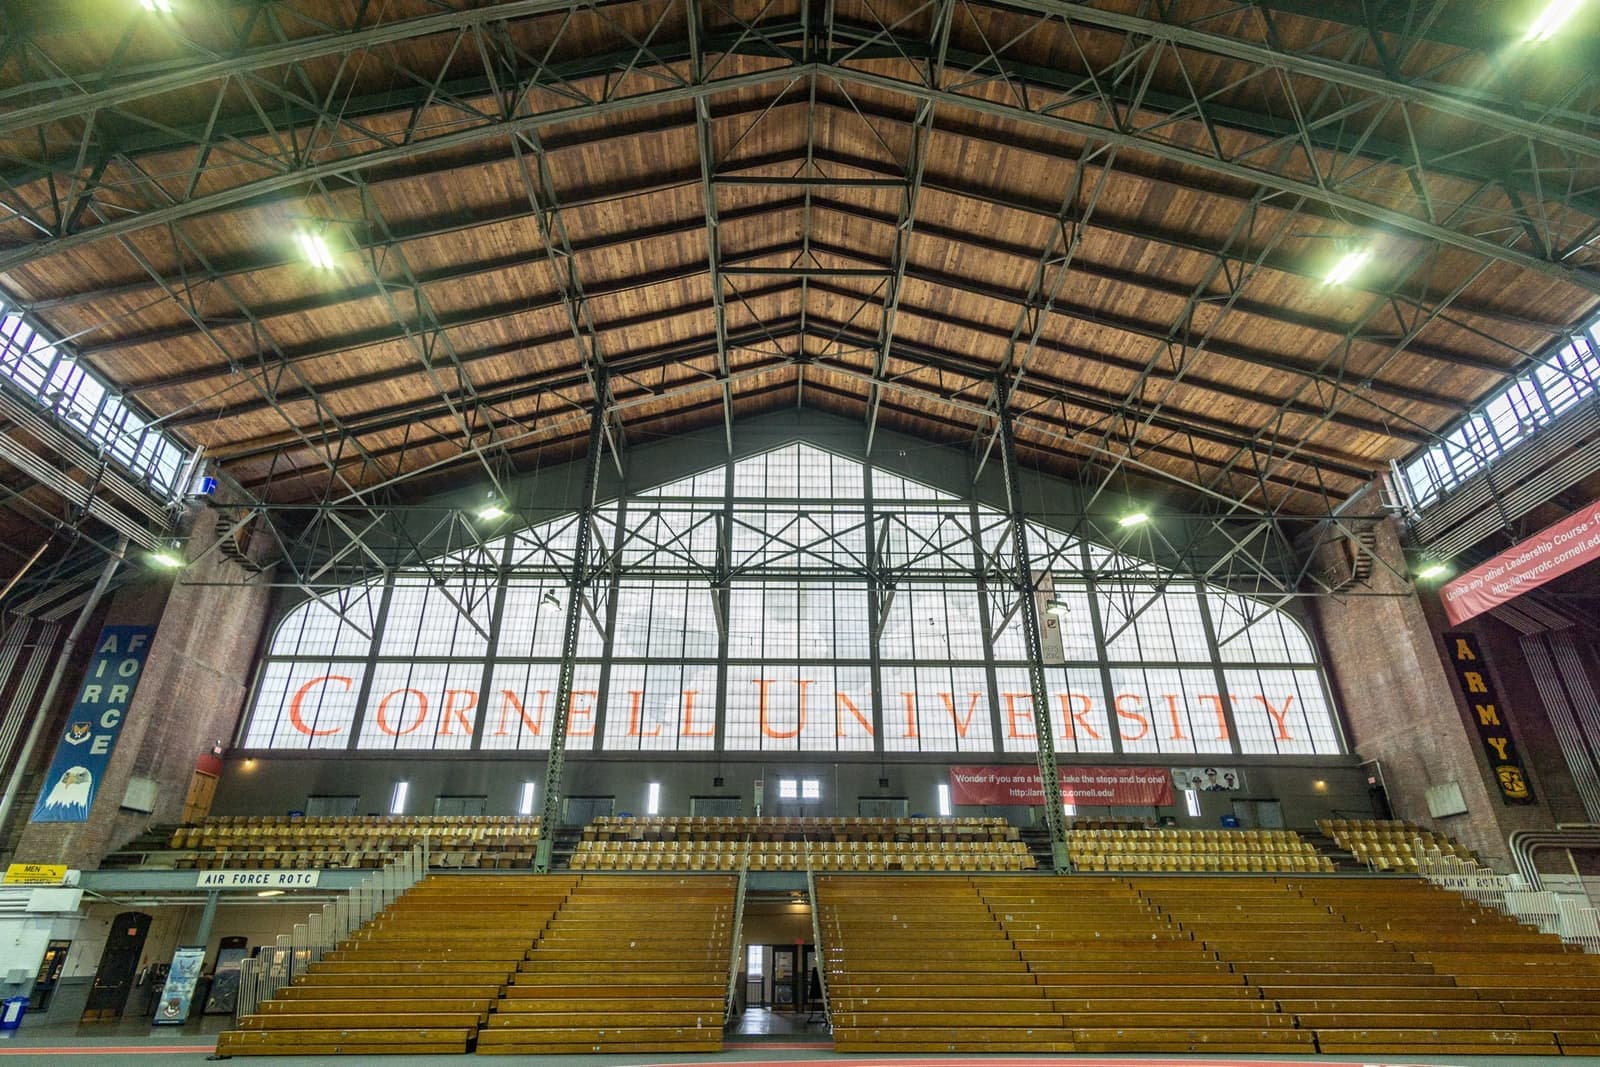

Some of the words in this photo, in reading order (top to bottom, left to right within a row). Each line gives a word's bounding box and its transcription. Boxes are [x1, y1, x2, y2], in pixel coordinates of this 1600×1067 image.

[1446, 583, 1470, 601] Unlike
[1469, 577, 1484, 590] any
[1484, 565, 1505, 582] other
[1505, 541, 1553, 571] Leadership
[1553, 522, 1588, 546] Course
[81, 634, 118, 704] AIR
[89, 634, 148, 756] FORCE
[1455, 638, 1508, 760] ARMY
[289, 675, 716, 737] CORNELL
[752, 678, 1294, 741] UNIVERSITY
[956, 774, 986, 783] Wonder
[988, 774, 994, 783] if
[996, 775, 1011, 785] you
[1012, 775, 1025, 783] are
[1081, 775, 1095, 783] the
[1096, 775, 1117, 785] steps
[1119, 775, 1134, 784] and
[1136, 775, 1146, 784] be
[24, 865, 40, 873] MEN
[204, 874, 225, 884] AIR
[232, 874, 270, 884] FORCE
[279, 874, 312, 884] ROTC
